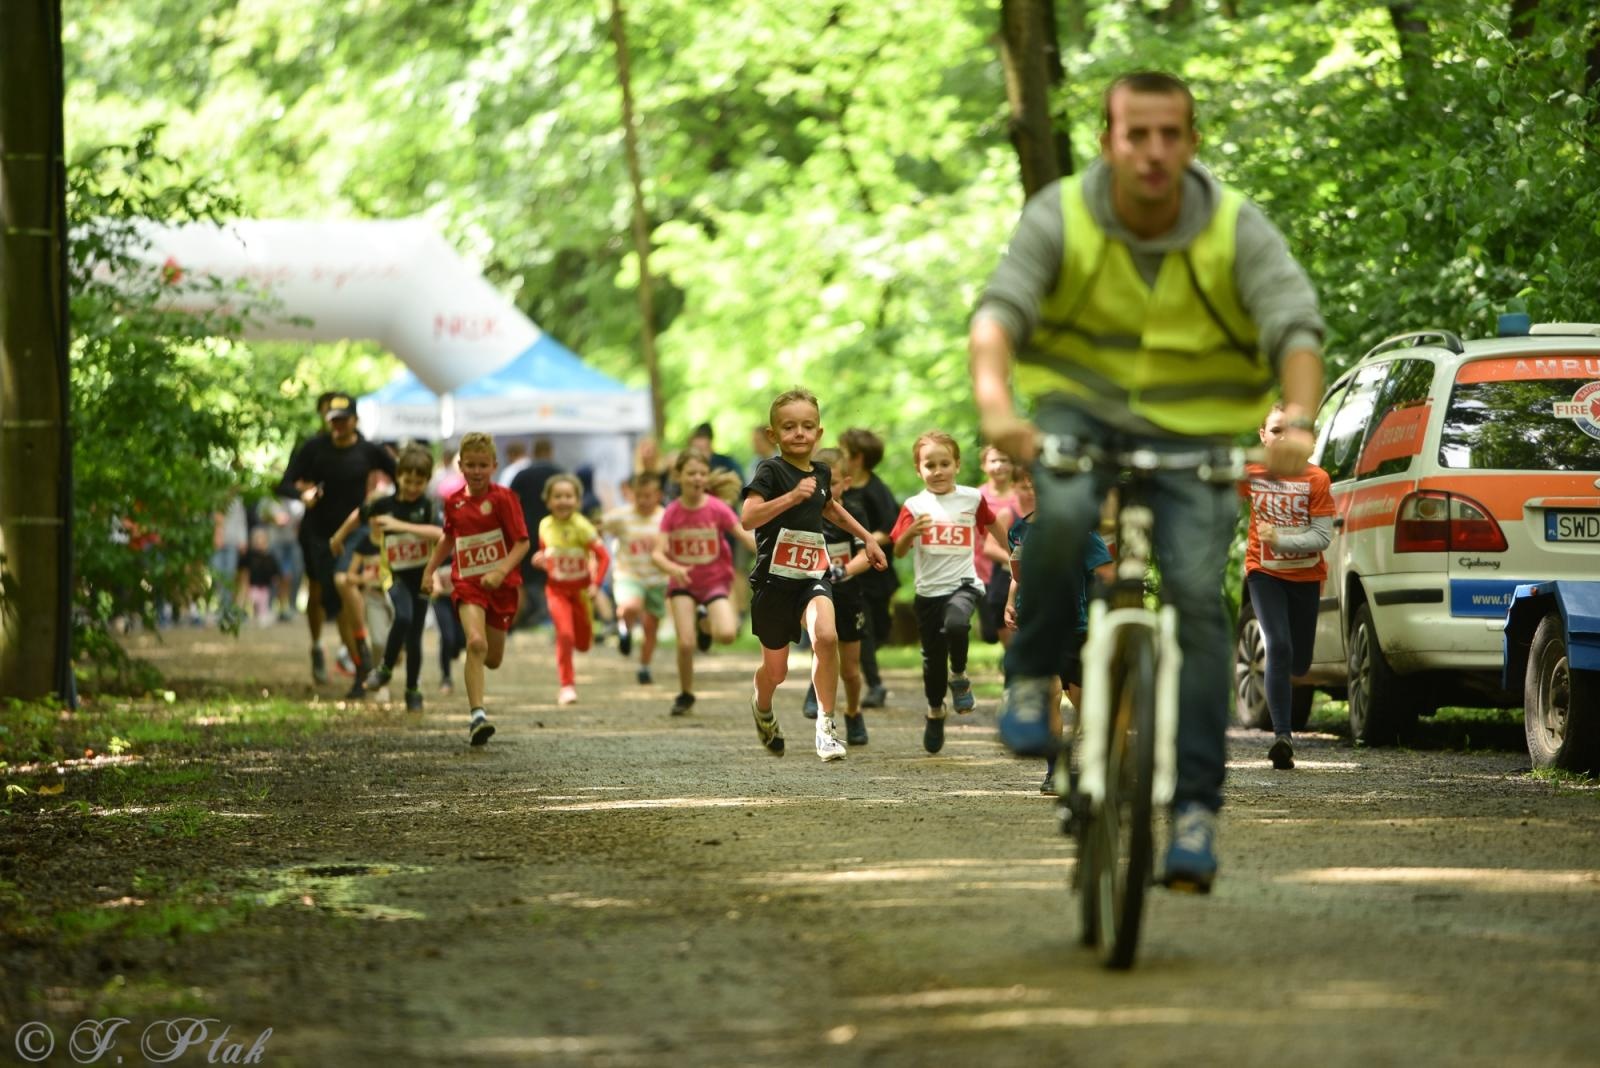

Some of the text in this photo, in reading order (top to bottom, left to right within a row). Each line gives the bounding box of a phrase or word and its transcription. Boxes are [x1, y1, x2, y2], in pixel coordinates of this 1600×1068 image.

[1555, 404, 1589, 415] FIRE
[928, 526, 964, 544] 145
[1559, 516, 1600, 538] SWD
[465, 544, 498, 567] 140
[680, 539, 710, 556] 141
[785, 546, 820, 570] 159
